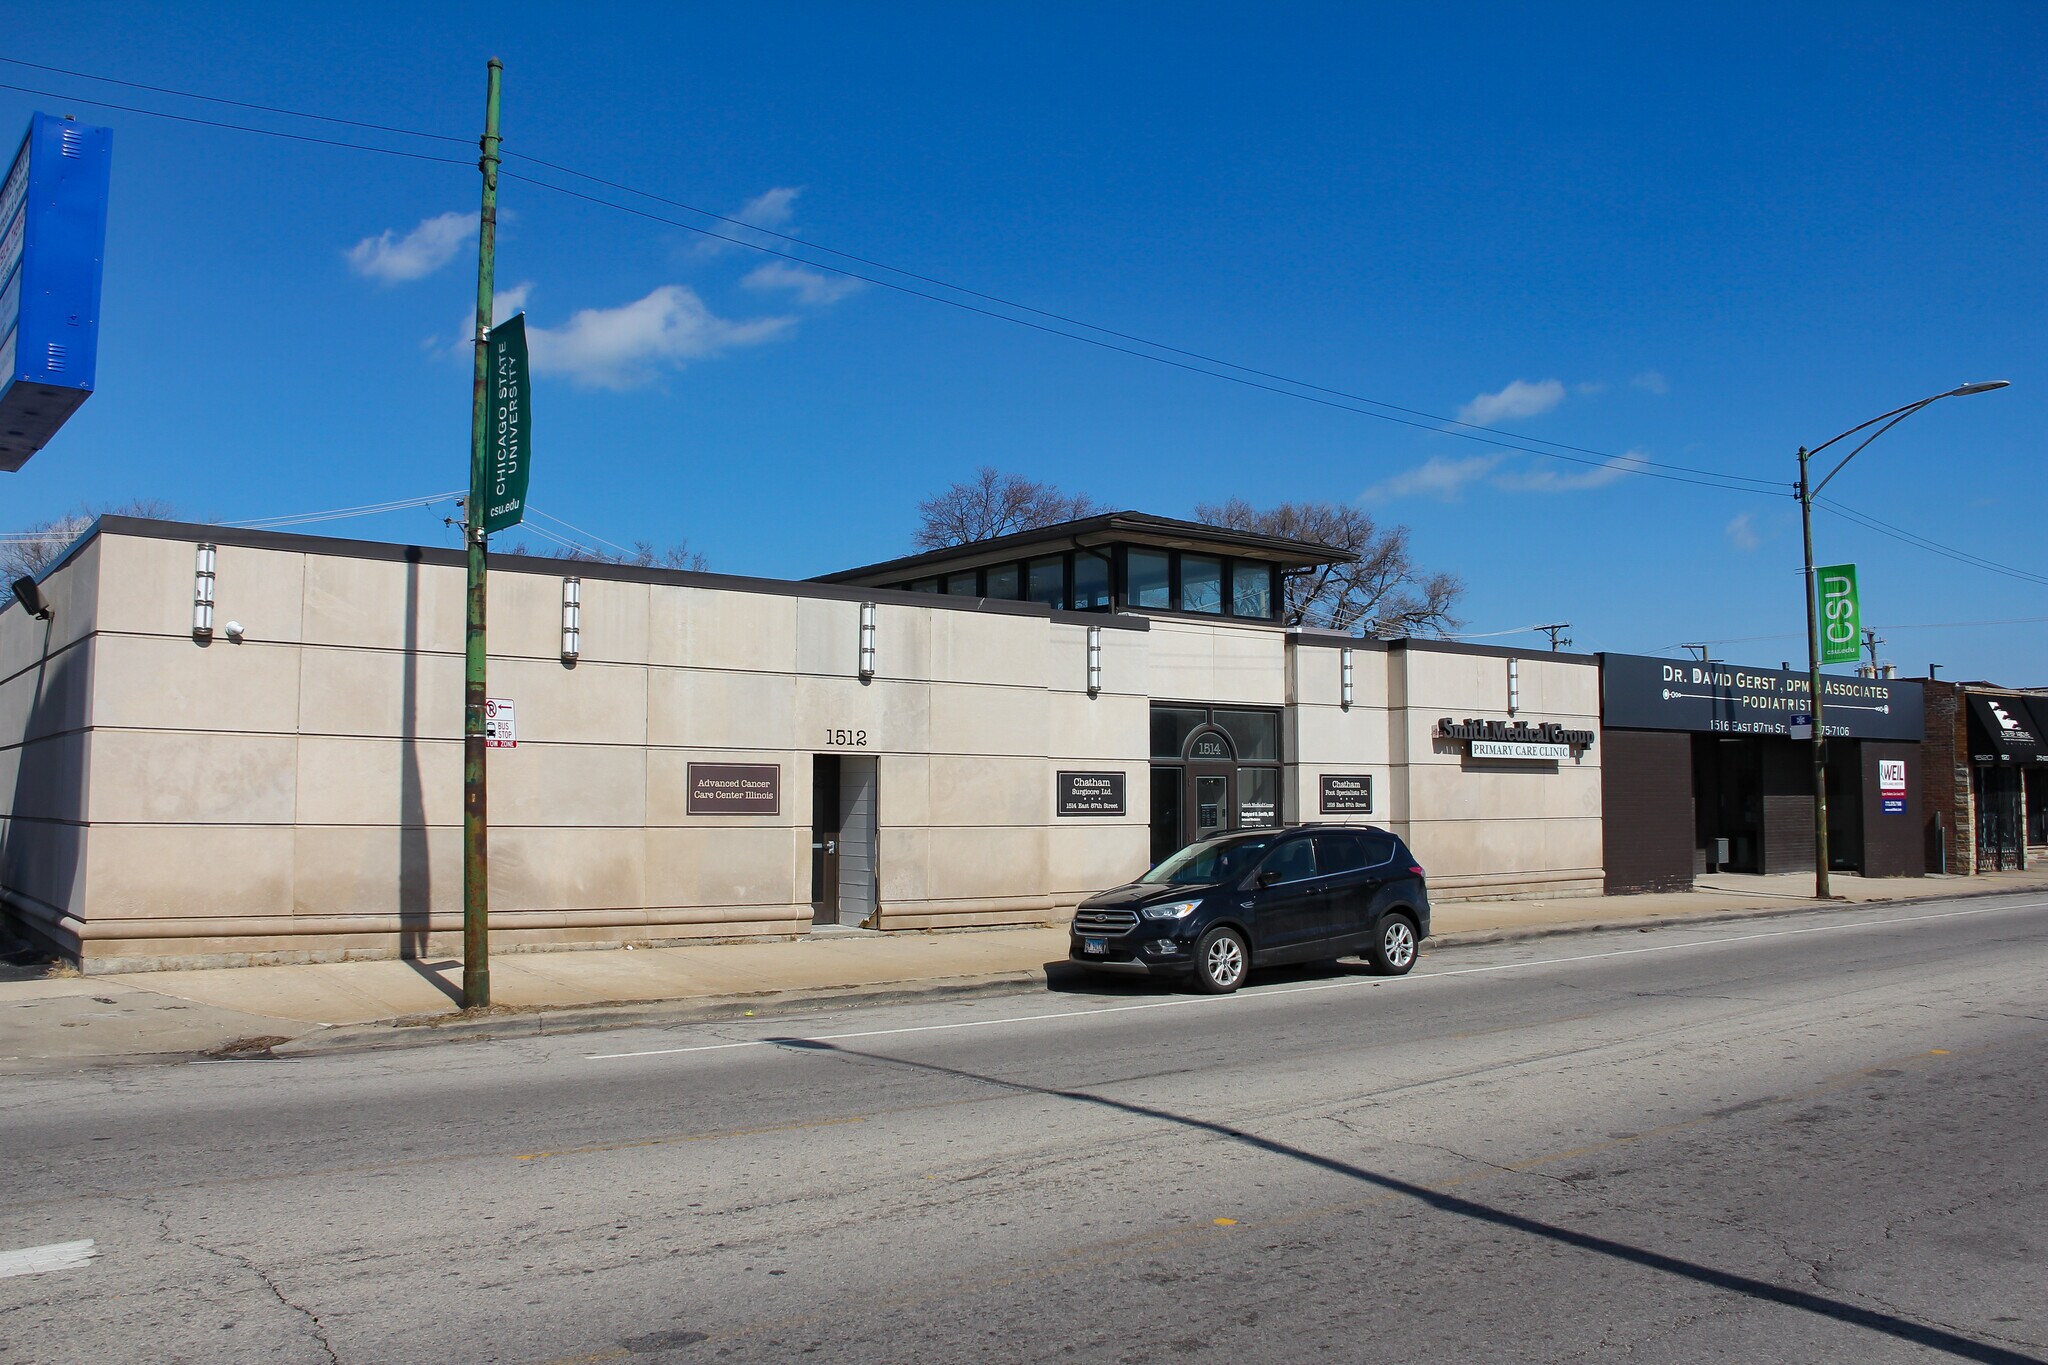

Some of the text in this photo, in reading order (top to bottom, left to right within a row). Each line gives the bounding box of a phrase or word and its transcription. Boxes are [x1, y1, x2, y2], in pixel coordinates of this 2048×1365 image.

[496, 341, 508, 496] CHICAGO STATE
[508, 356, 518, 474] UNIVERSITY
[490, 498, 520, 518] csu.edu
[1824, 576, 1854, 643] CSU
[1826, 647, 1855, 655] csu.edu
[1786, 679, 1810, 693] DPM
[497, 722, 510, 730] BUS
[1710, 720, 1730, 731] 1516
[1821, 725, 1850, 737] 75-7106
[497, 730, 512, 739] STOP
[826, 729, 867, 746] 1512
[1437, 717, 1595, 751] Smith Medical Group
[1199, 742, 1221, 755] 1514
[1473, 743, 1569, 758] PRIMARY CARE CLINIC
[1884, 764, 1904, 781] WEIL
[697, 779, 771, 788] Advanced Cancer
[1073, 777, 1111, 787] Chatham
[1332, 780, 1361, 789] Chatham
[694, 790, 774, 800] Care Center Illinois
